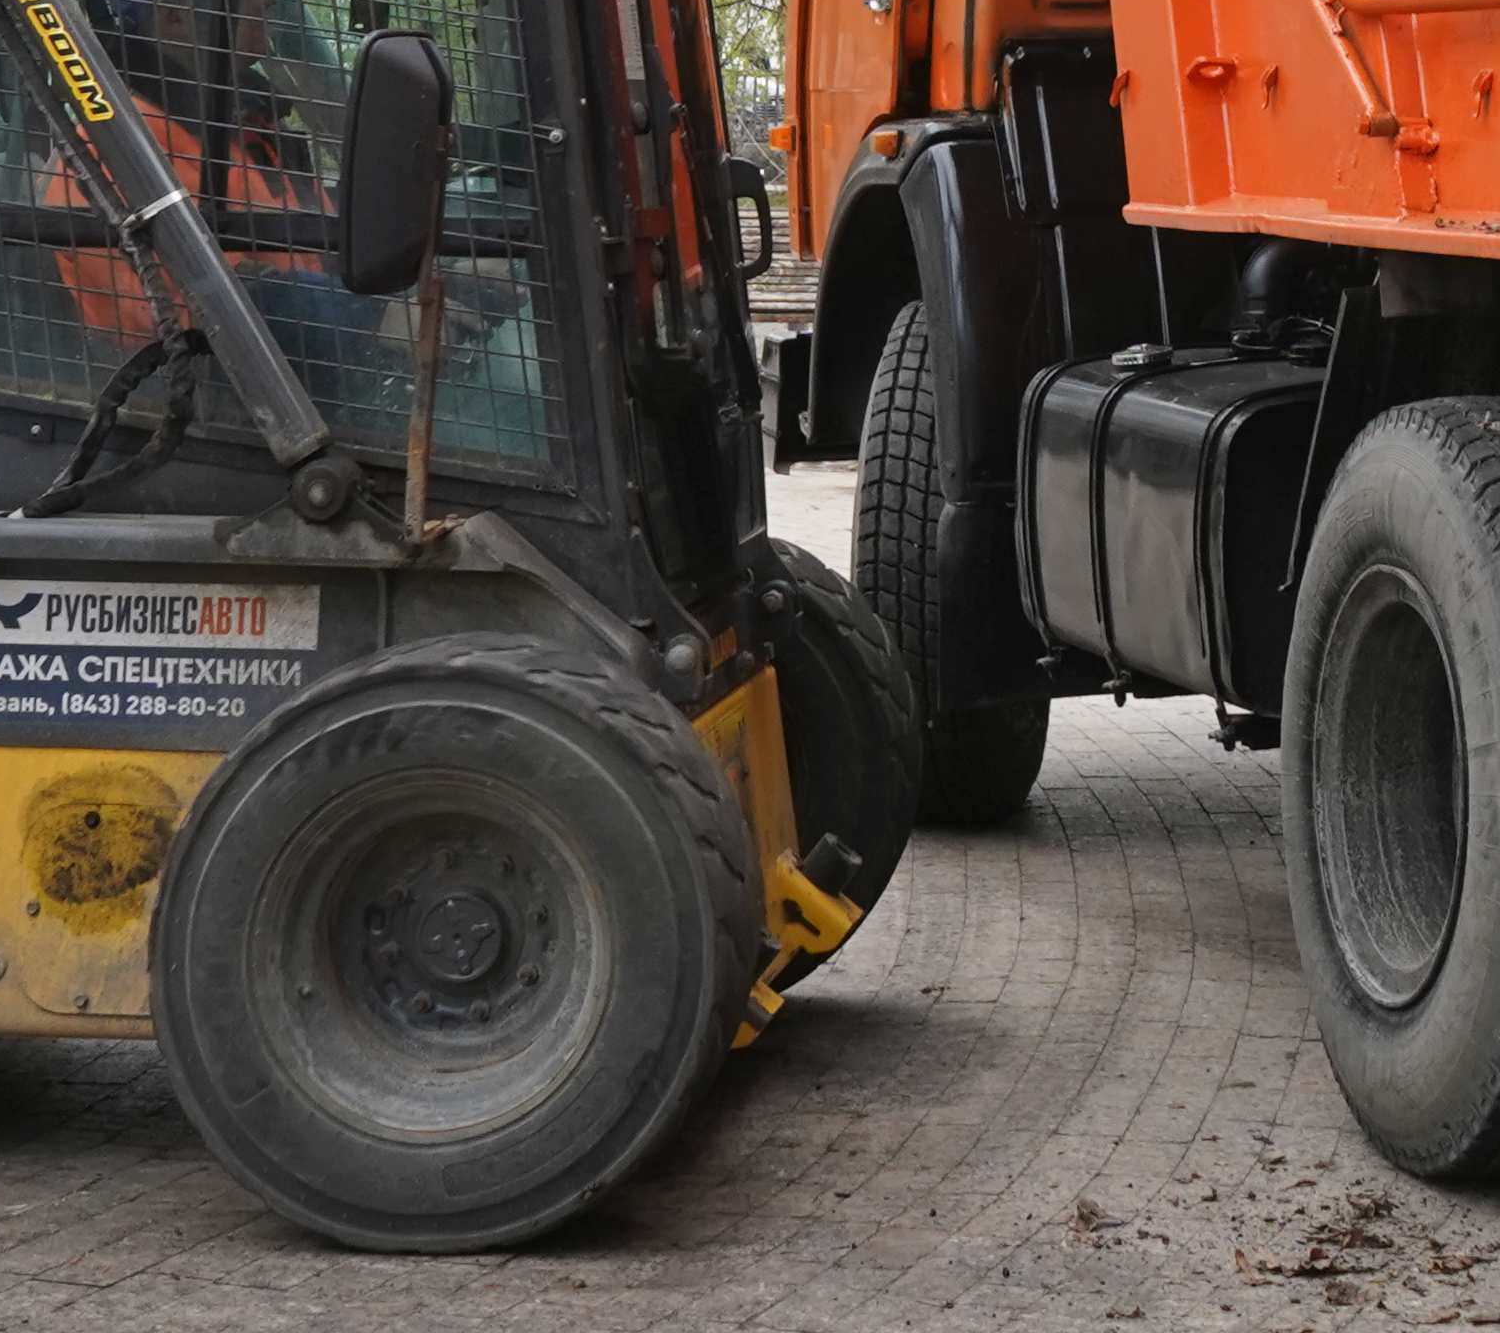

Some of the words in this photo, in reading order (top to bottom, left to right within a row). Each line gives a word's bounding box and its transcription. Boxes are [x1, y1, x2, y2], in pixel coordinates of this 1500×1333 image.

[27, 3, 115, 121] BOOM
[46, 593, 267, 636] РУСБИЗНЕСАВТО
[77, 655, 302, 689] СПЕЦТЕХНИКИ
[61, 693, 120, 716] (843)
[126, 696, 246, 717] 288-80-20
